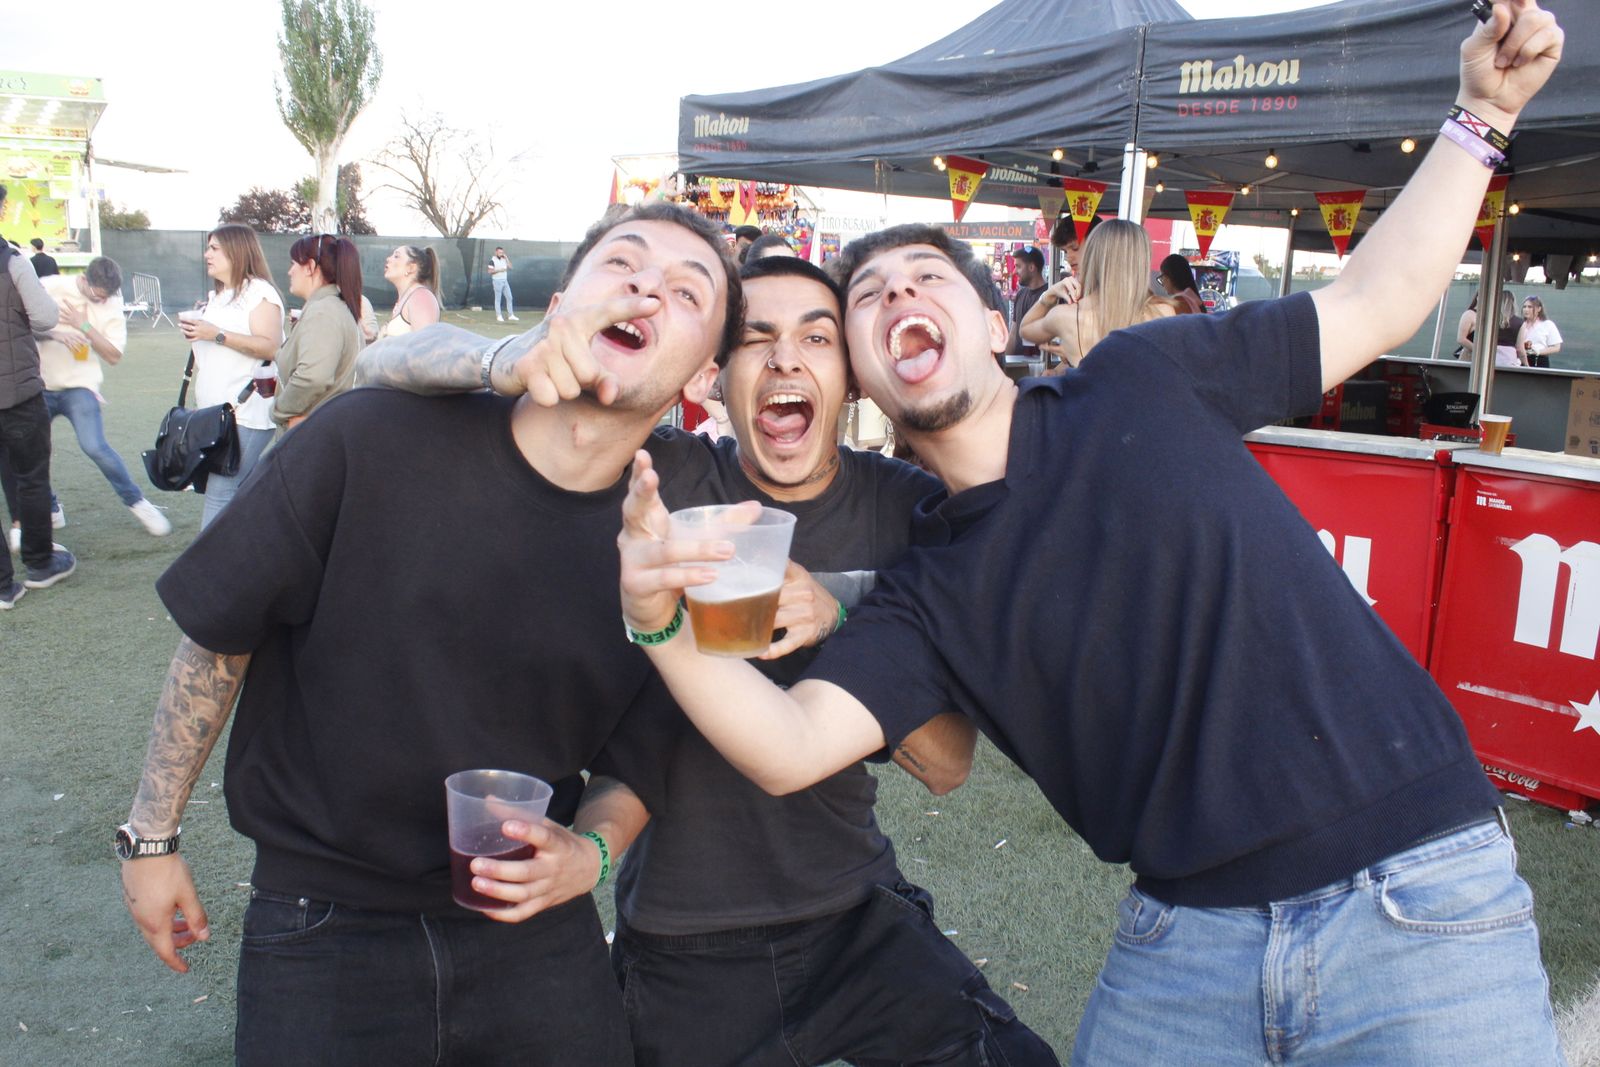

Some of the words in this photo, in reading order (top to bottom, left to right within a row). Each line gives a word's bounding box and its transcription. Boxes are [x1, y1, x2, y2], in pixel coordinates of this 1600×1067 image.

[1179, 54, 1300, 94] Mahou
[1178, 99, 1240, 117] DESDE
[1250, 95, 1298, 112] 1890
[694, 112, 750, 138] Mahou
